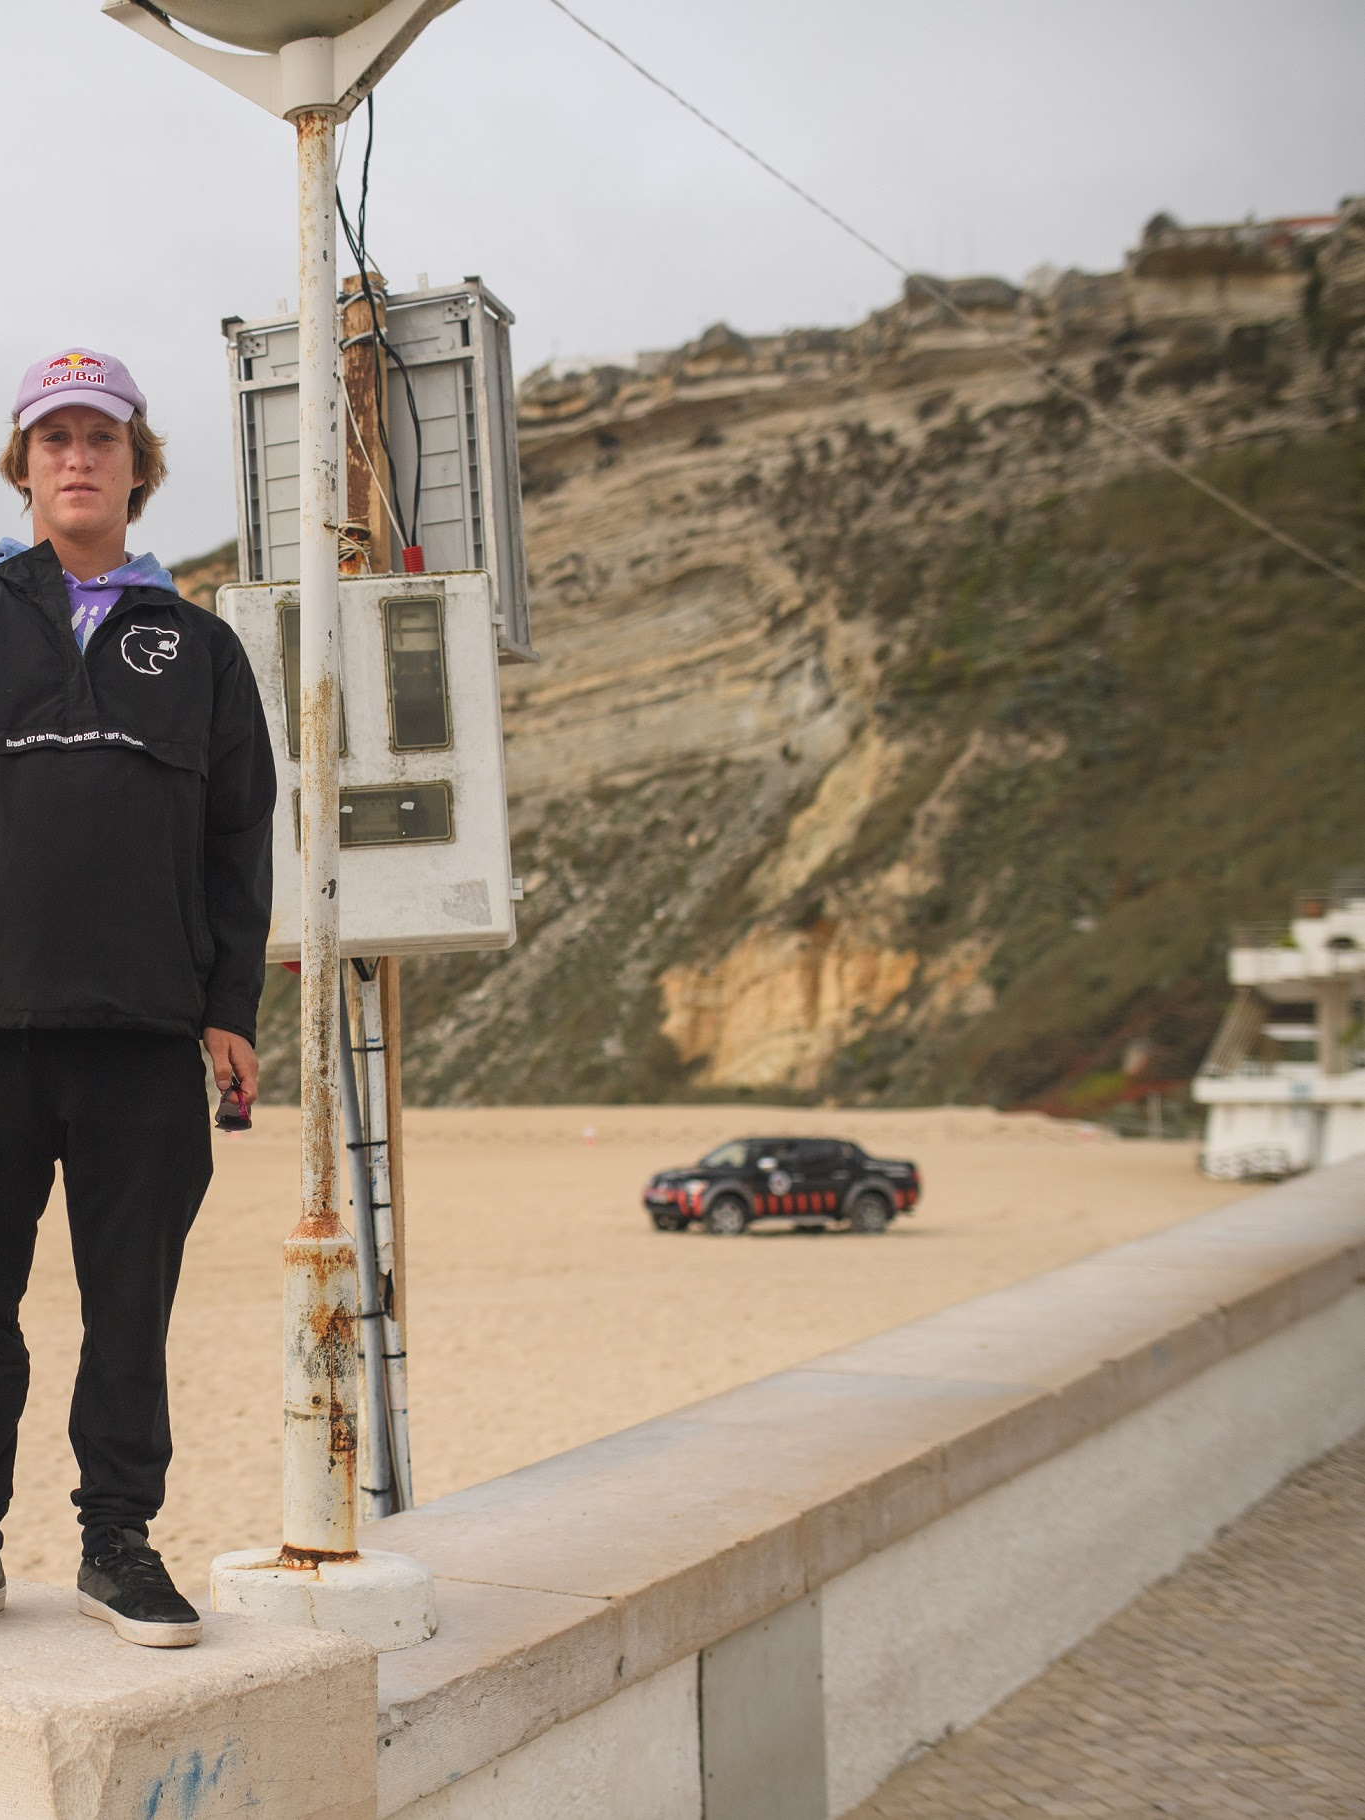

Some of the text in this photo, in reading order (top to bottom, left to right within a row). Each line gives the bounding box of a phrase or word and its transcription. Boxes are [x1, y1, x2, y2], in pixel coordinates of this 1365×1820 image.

[42, 371, 104, 388] Red Bull
[27, 735, 35, 743] 07
[36, 734, 45, 742] de
[46, 733, 73, 744] fevereiro
[74, 734, 83, 742] de
[84, 731, 100, 741] 2021
